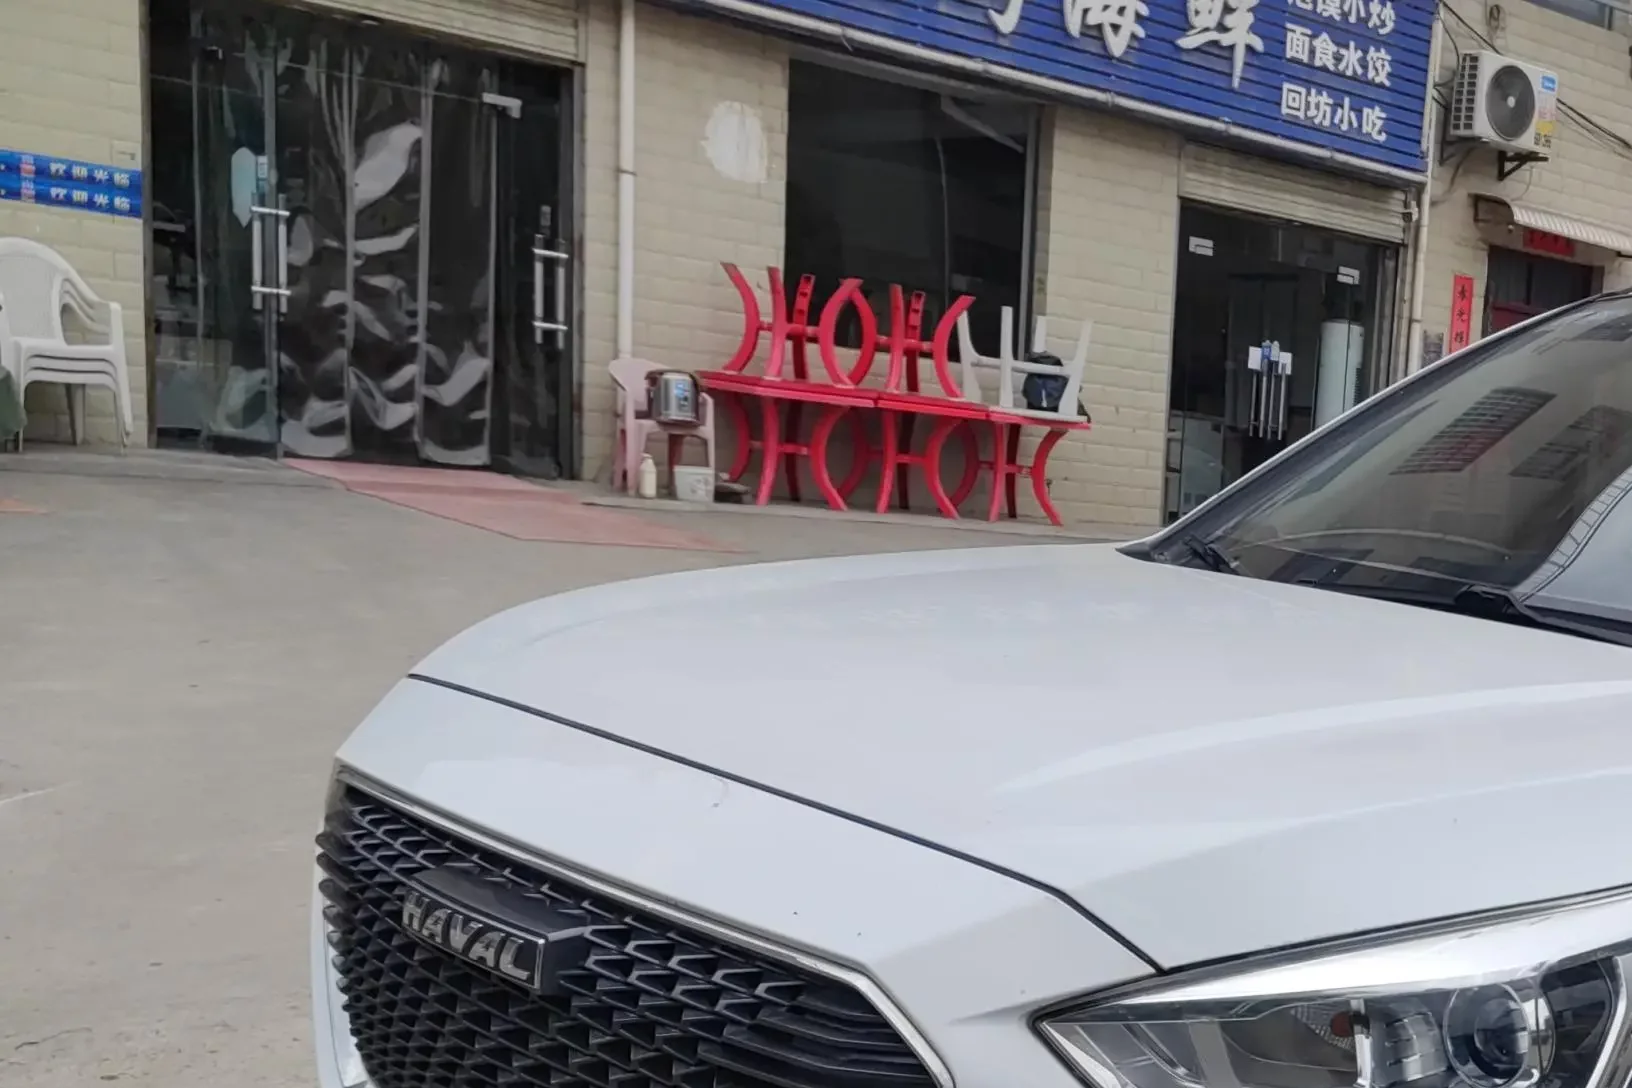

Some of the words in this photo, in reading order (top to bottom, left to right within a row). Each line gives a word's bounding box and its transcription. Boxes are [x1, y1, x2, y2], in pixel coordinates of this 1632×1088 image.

[986, 0, 1265, 90] 海鲜
[1287, 0, 1397, 35] 馍小炒
[1285, 22, 1392, 87] 面食水饺
[1280, 81, 1388, 143] 回坊小吃
[402, 890, 531, 981] HAVAL
